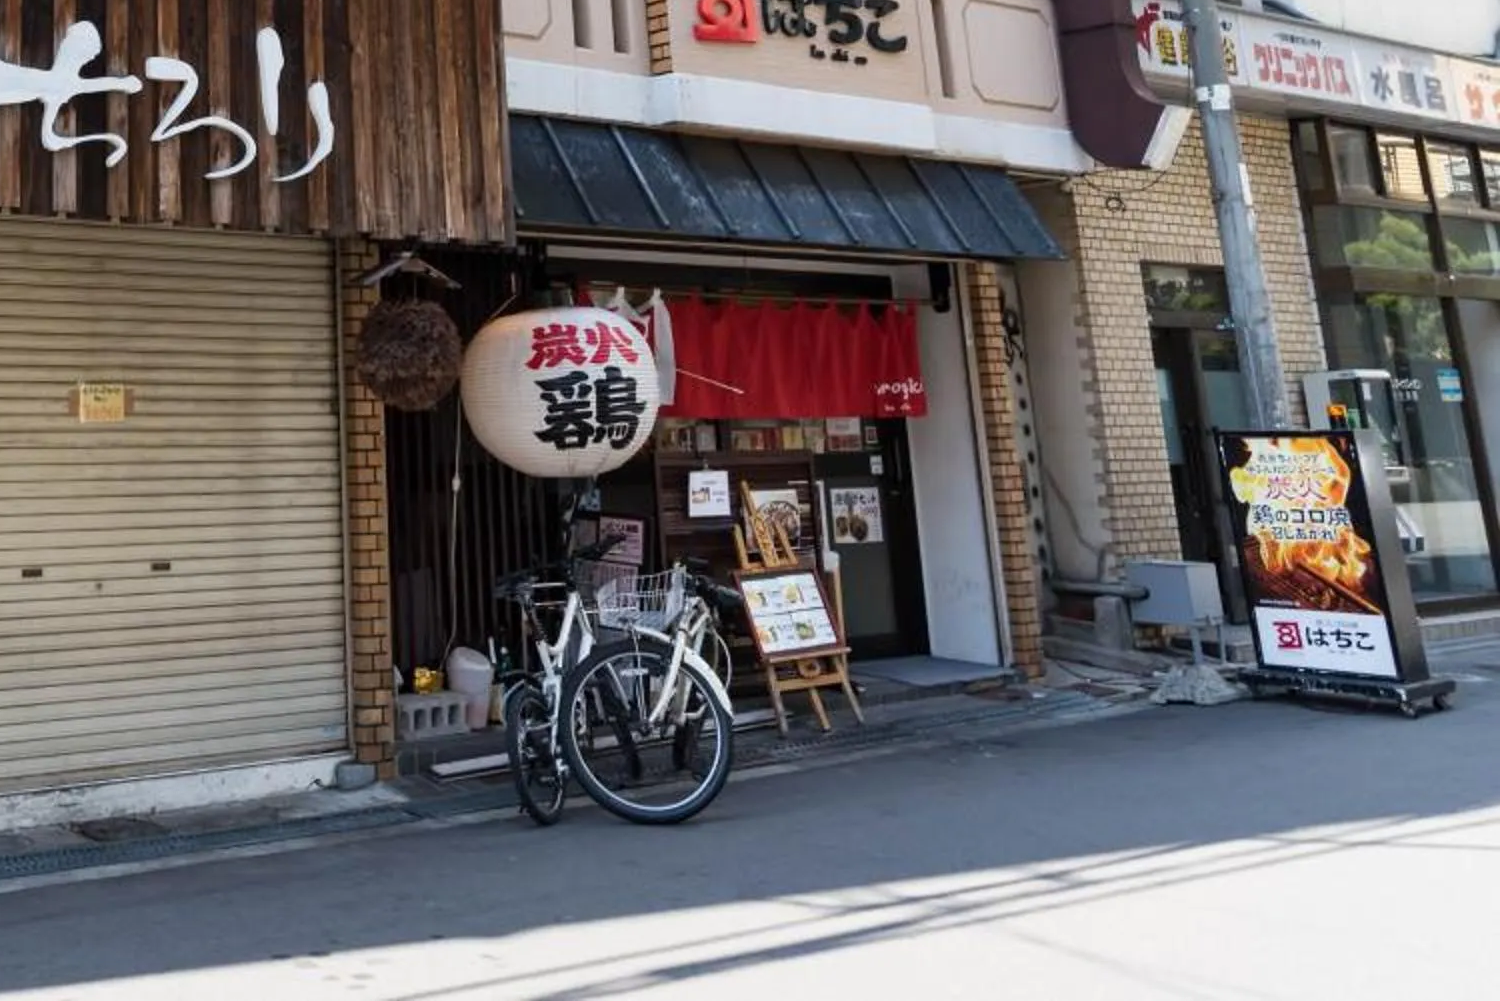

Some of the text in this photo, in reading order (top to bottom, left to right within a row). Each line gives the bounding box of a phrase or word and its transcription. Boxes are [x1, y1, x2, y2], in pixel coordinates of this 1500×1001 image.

[525, 319, 640, 371] 炭火
[1305, 626, 1375, 651] はちこ
